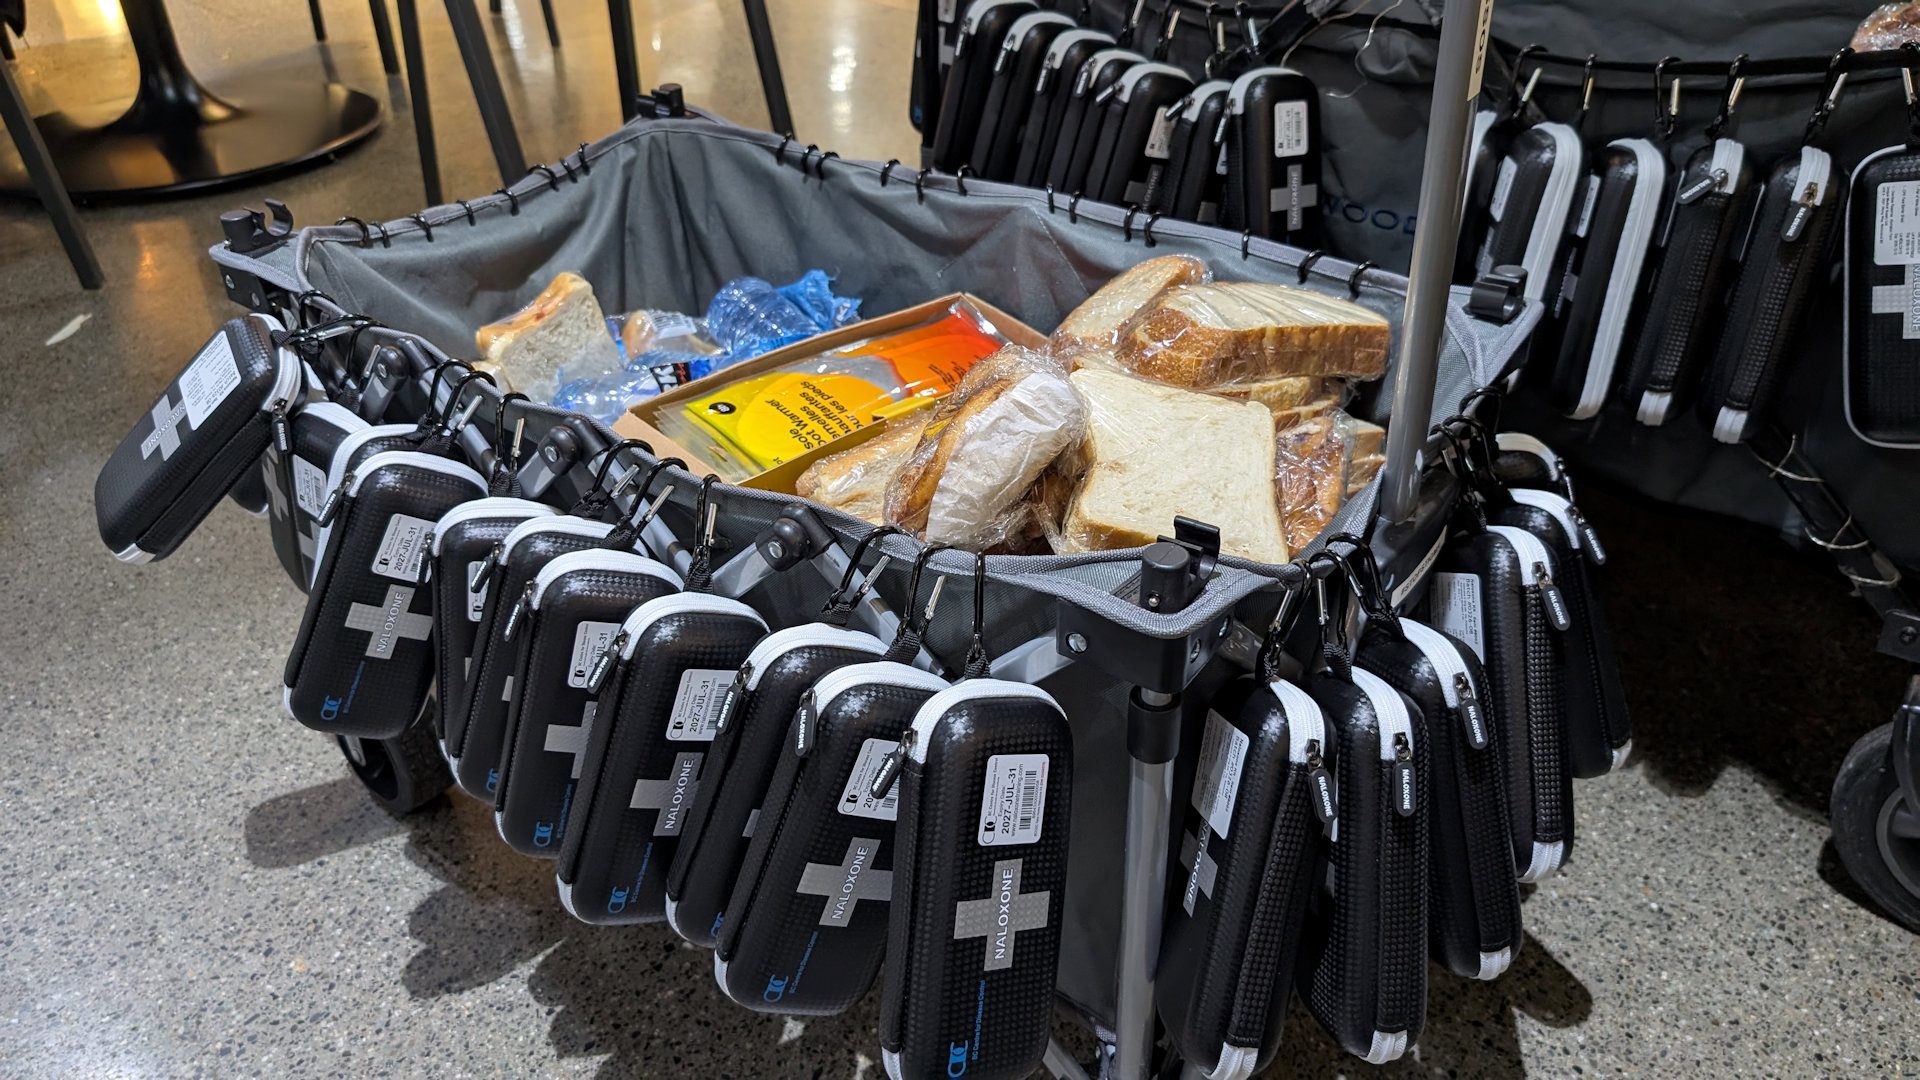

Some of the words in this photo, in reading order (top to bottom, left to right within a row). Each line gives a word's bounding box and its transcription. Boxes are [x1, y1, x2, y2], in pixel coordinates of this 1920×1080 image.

[1786, 207, 1806, 237] NALOXONE
[1912, 264, 1920, 332] NALOXONE
[801, 381, 834, 400] pieds
[830, 400, 848, 414] les
[146, 404, 186, 450] NALOXONE
[765, 399, 808, 430] Warmer
[800, 405, 841, 439] emelles
[790, 428, 814, 449] sole
[806, 429, 827, 446] oot
[394, 526, 417, 570] 2027-JUL-31
[376, 592, 406, 653] NALOXONE
[1547, 590, 1566, 625] NALOXONE
[690, 681, 710, 732] 2027-JUL-31
[717, 691, 734, 728] NALOXONE
[1467, 705, 1483, 744] NALOXONE
[798, 709, 807, 749] NALOXONE
[1230, 735, 1240, 758] Batch
[665, 760, 694, 829] NALOXONE
[1002, 768, 1016, 834] 2027-JUL-31
[1012, 764, 1023, 836] www.naloxonetraining.com
[1318, 776, 1334, 817] NALOXONE
[1402, 769, 1411, 810] NALOXONE
[1187, 821, 1209, 904] NALOXONE
[832, 846, 868, 920] NALOXONE
[994, 868, 1014, 959] NALOXONE
[977, 979, 986, 1000] Control
[975, 1000, 984, 1023] Disease
[971, 1050, 978, 1060] BC
[972, 1031, 980, 1050] Centre
